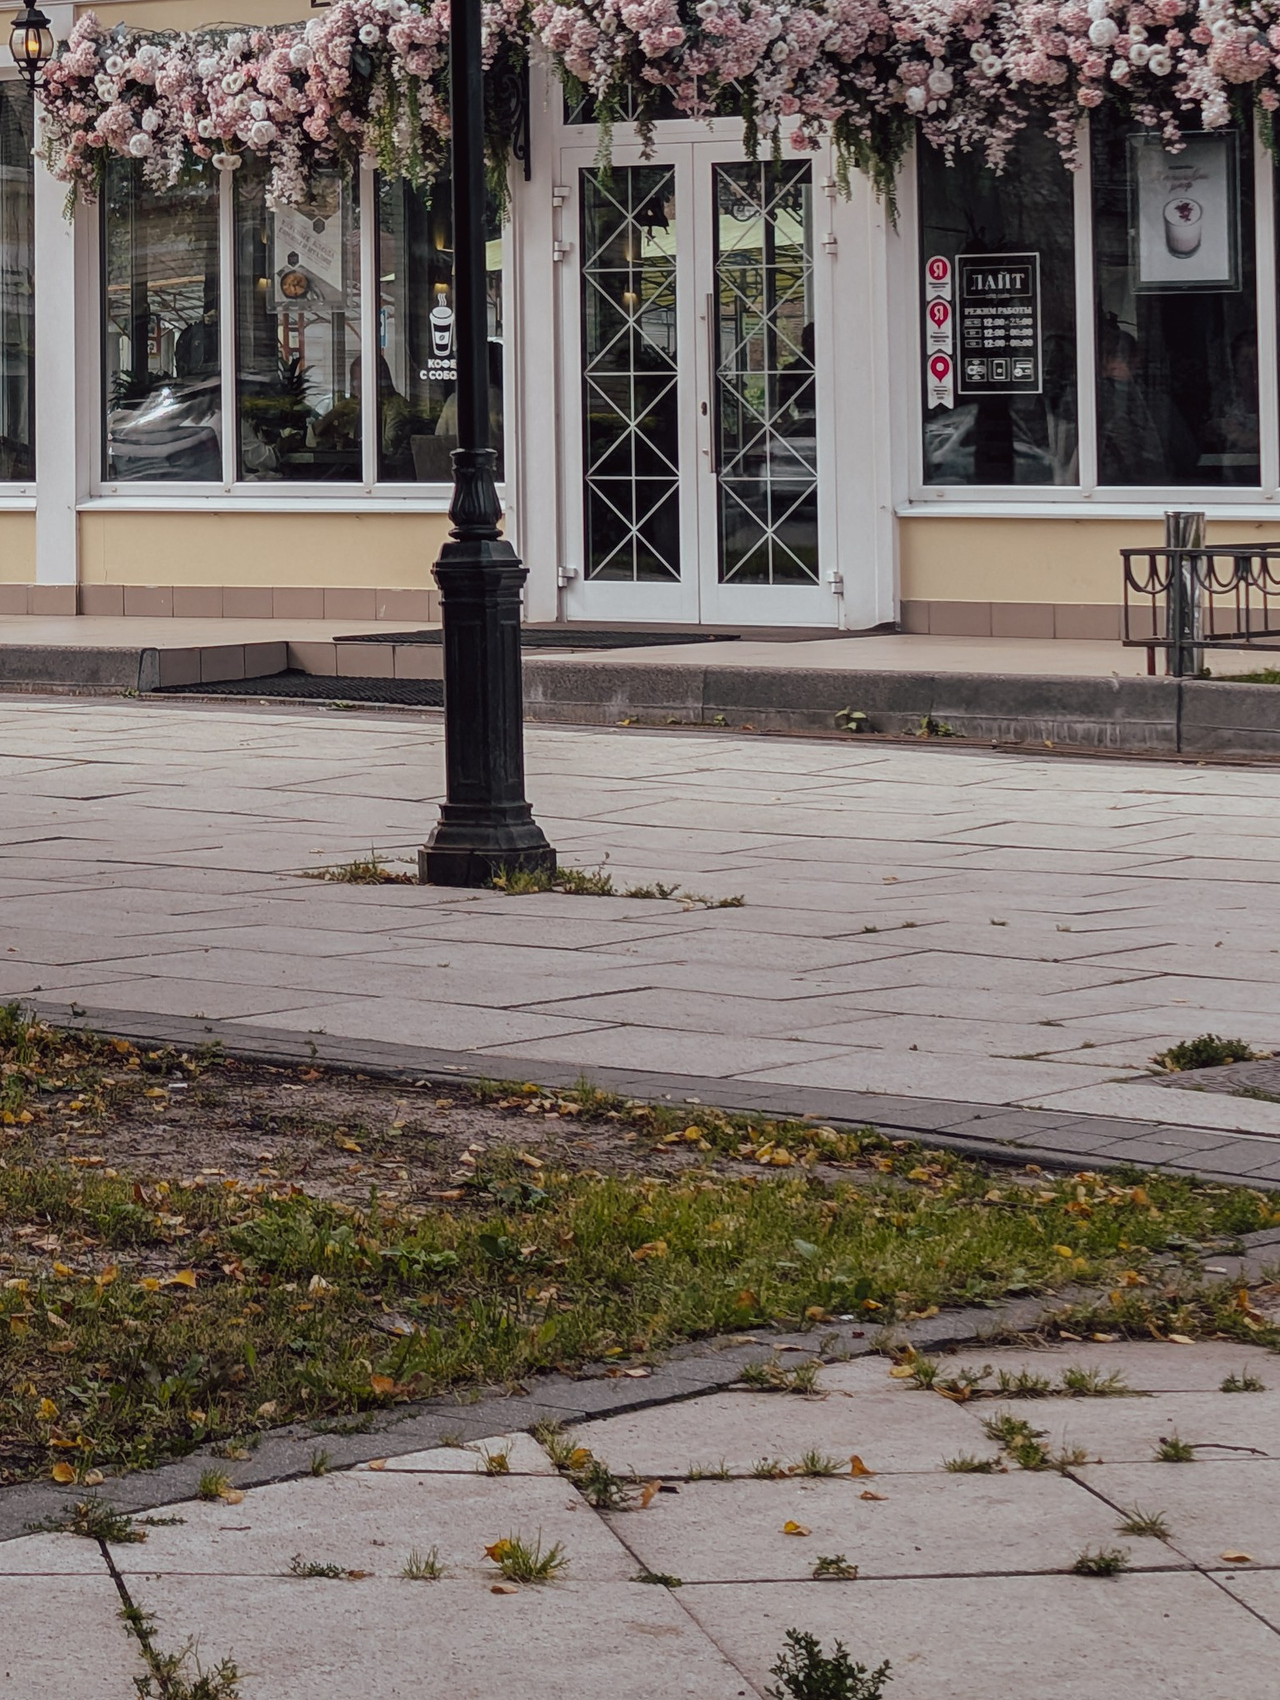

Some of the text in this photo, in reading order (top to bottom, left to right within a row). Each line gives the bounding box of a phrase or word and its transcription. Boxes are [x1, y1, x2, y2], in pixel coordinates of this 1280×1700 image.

[971, 272, 1025, 290] ЛАЙТ
[964, 306, 1032, 315] РЕЖИМ РАБОТЫ
[428, 359, 457, 369] КОФЕ
[429, 370, 457, 380] СОБО
